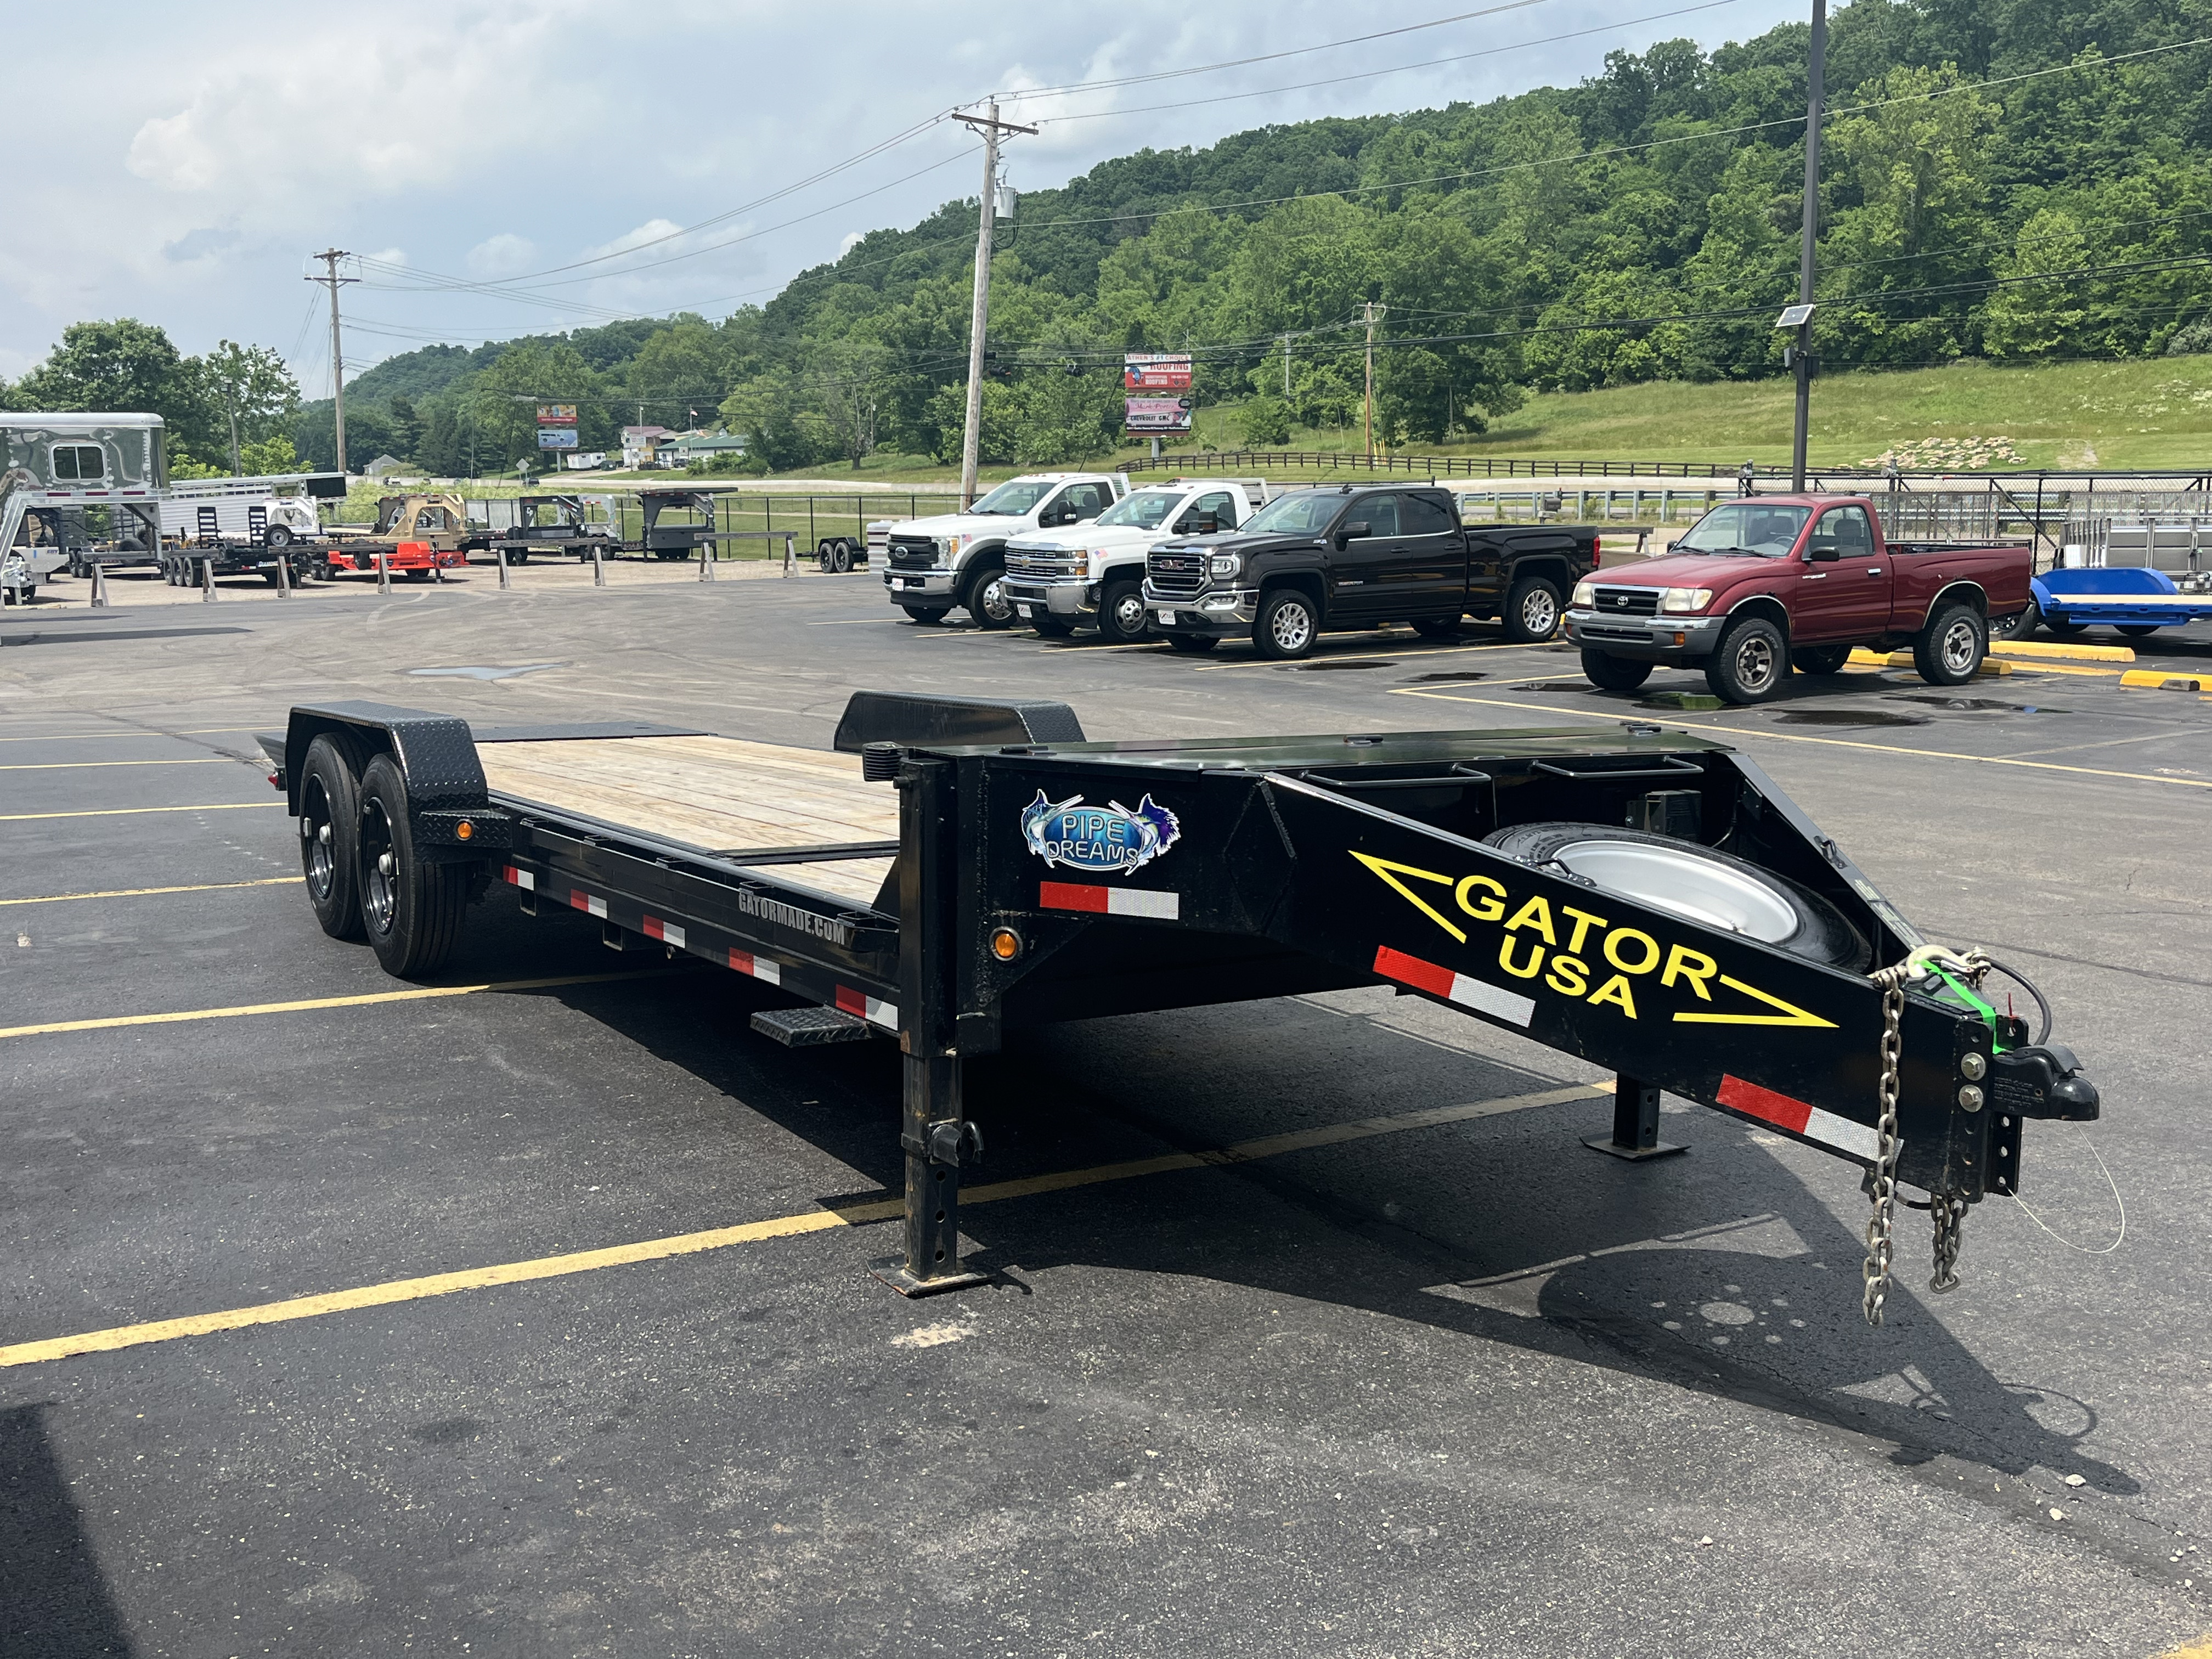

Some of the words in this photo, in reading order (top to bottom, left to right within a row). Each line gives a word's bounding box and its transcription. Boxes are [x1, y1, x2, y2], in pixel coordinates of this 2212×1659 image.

[1159, 560, 1185, 571] GMC
[1061, 814, 1126, 843] PIPE
[1046, 840, 1140, 866] DREAMS
[738, 892, 845, 946] GATORMADE.COM
[1454, 874, 1718, 1002] GATOR
[1498, 934, 1638, 1020] USA
